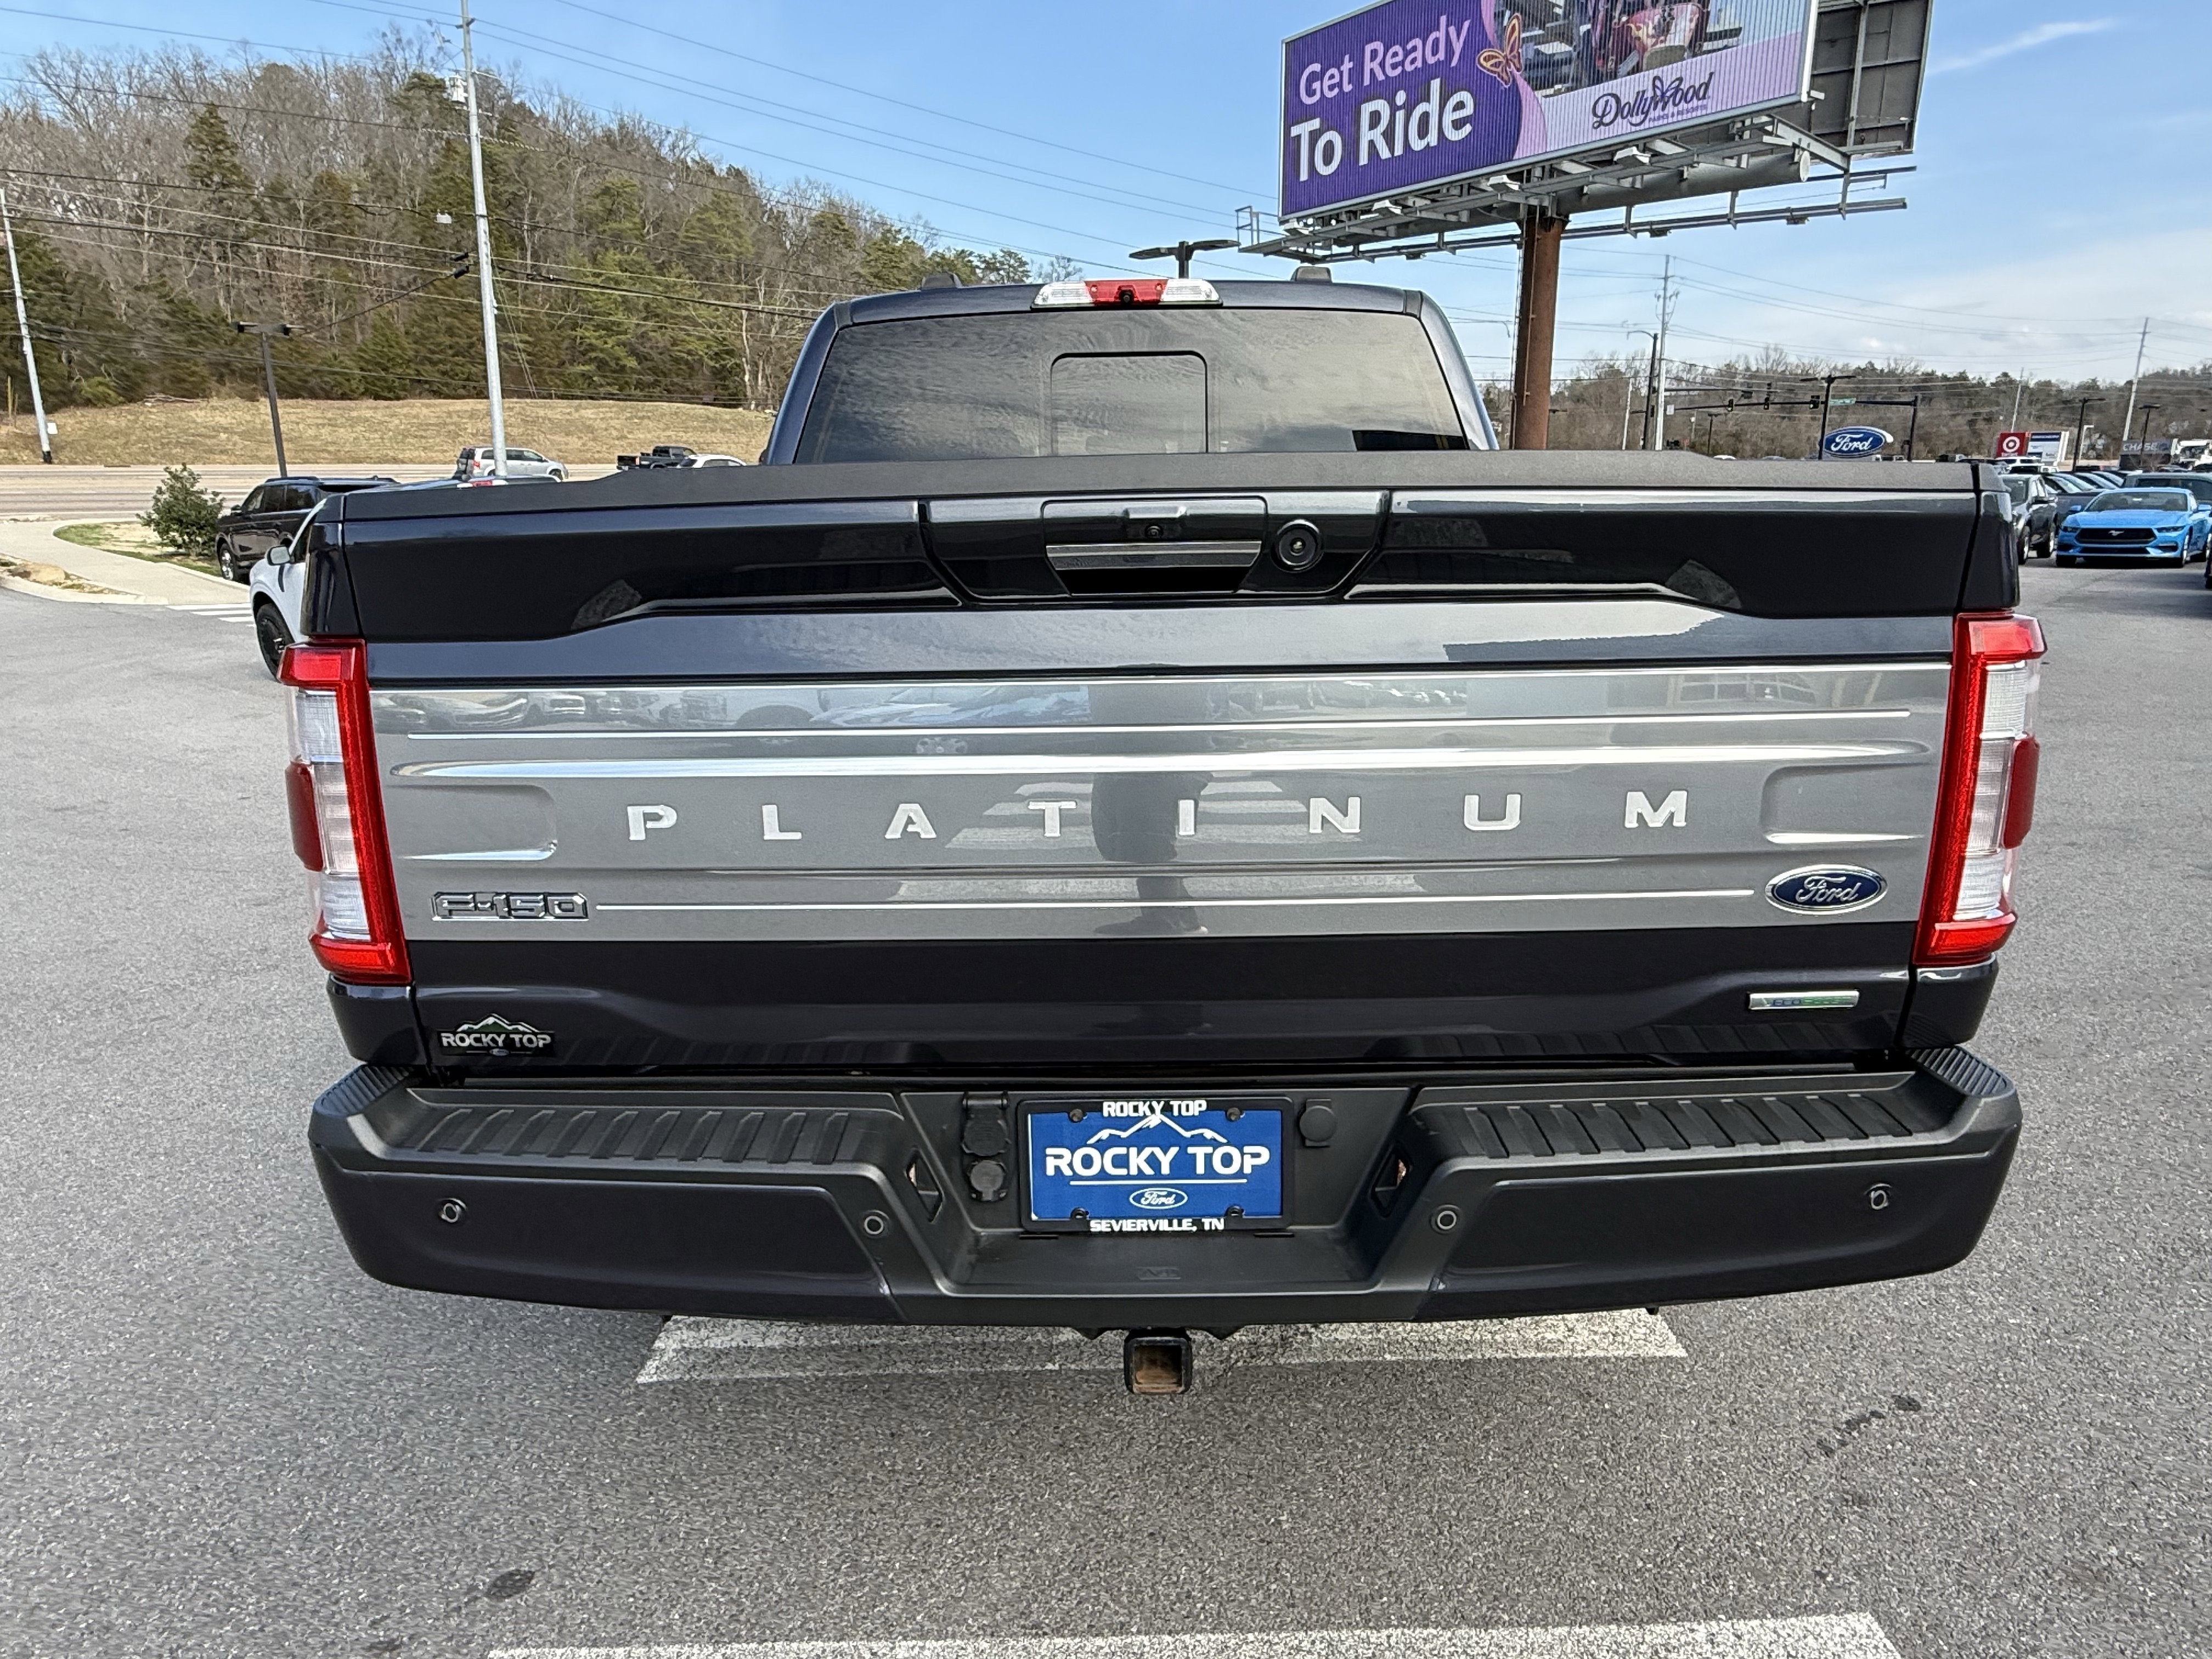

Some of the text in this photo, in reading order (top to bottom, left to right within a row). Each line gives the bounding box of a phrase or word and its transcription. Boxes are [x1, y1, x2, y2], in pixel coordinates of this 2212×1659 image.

[1299, 15, 1471, 105] Get Ready
[1290, 78, 1474, 182] To Ride
[1831, 434, 1874, 451] Ford
[2123, 442, 2157, 451] CHASE
[627, 790, 1688, 841] PLATINUM
[1796, 876, 1861, 902] Ford
[431, 891, 589, 921] F-150
[441, 1033, 551, 1048] ROCKY TOP
[1103, 1099, 1207, 1117] ROCKY TOP
[1046, 1146, 1271, 1176] ROCKY TOP
[1141, 1190, 1175, 1205] Ford
[1090, 1219, 1224, 1232] SEVIERVILLE, TN
